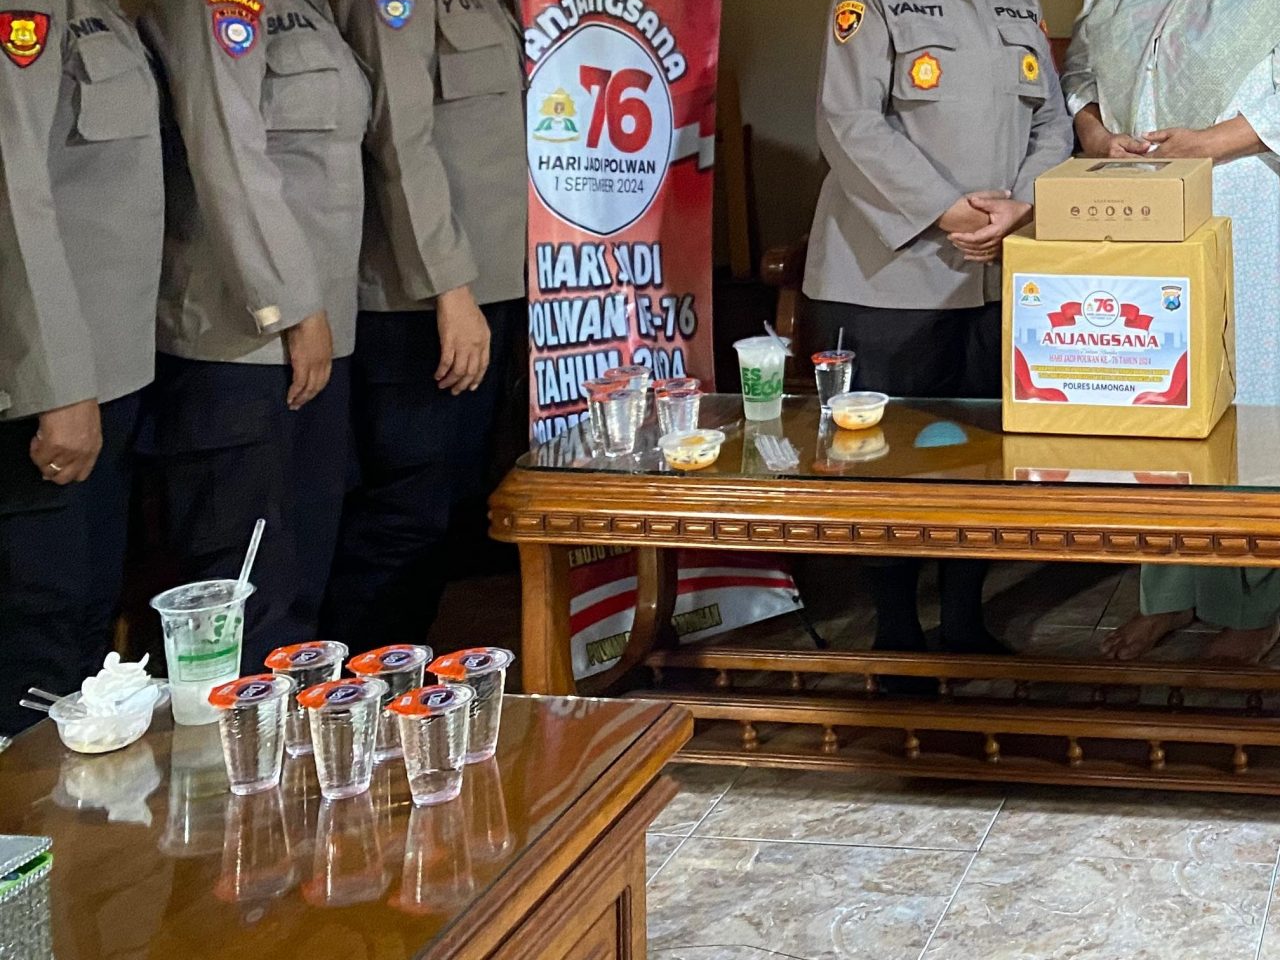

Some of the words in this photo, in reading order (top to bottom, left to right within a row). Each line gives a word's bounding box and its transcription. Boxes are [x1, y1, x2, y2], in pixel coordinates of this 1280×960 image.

[887, 2, 943, 17] YANTI
[994, 6, 1038, 23] POLRI
[579, 65, 653, 153] 76
[538, 155, 582, 171] HARI
[584, 157, 603, 172] JADI
[604, 158, 656, 174] POLWAN
[617, 179, 644, 193] 2024
[1094, 298, 1115, 313] 76
[529, 293, 628, 347] OLWAN
[1042, 331, 1159, 348] ANJANGSANA
[1063, 382, 1090, 391] POLRES
[1092, 383, 1136, 393] LAMONGAN
